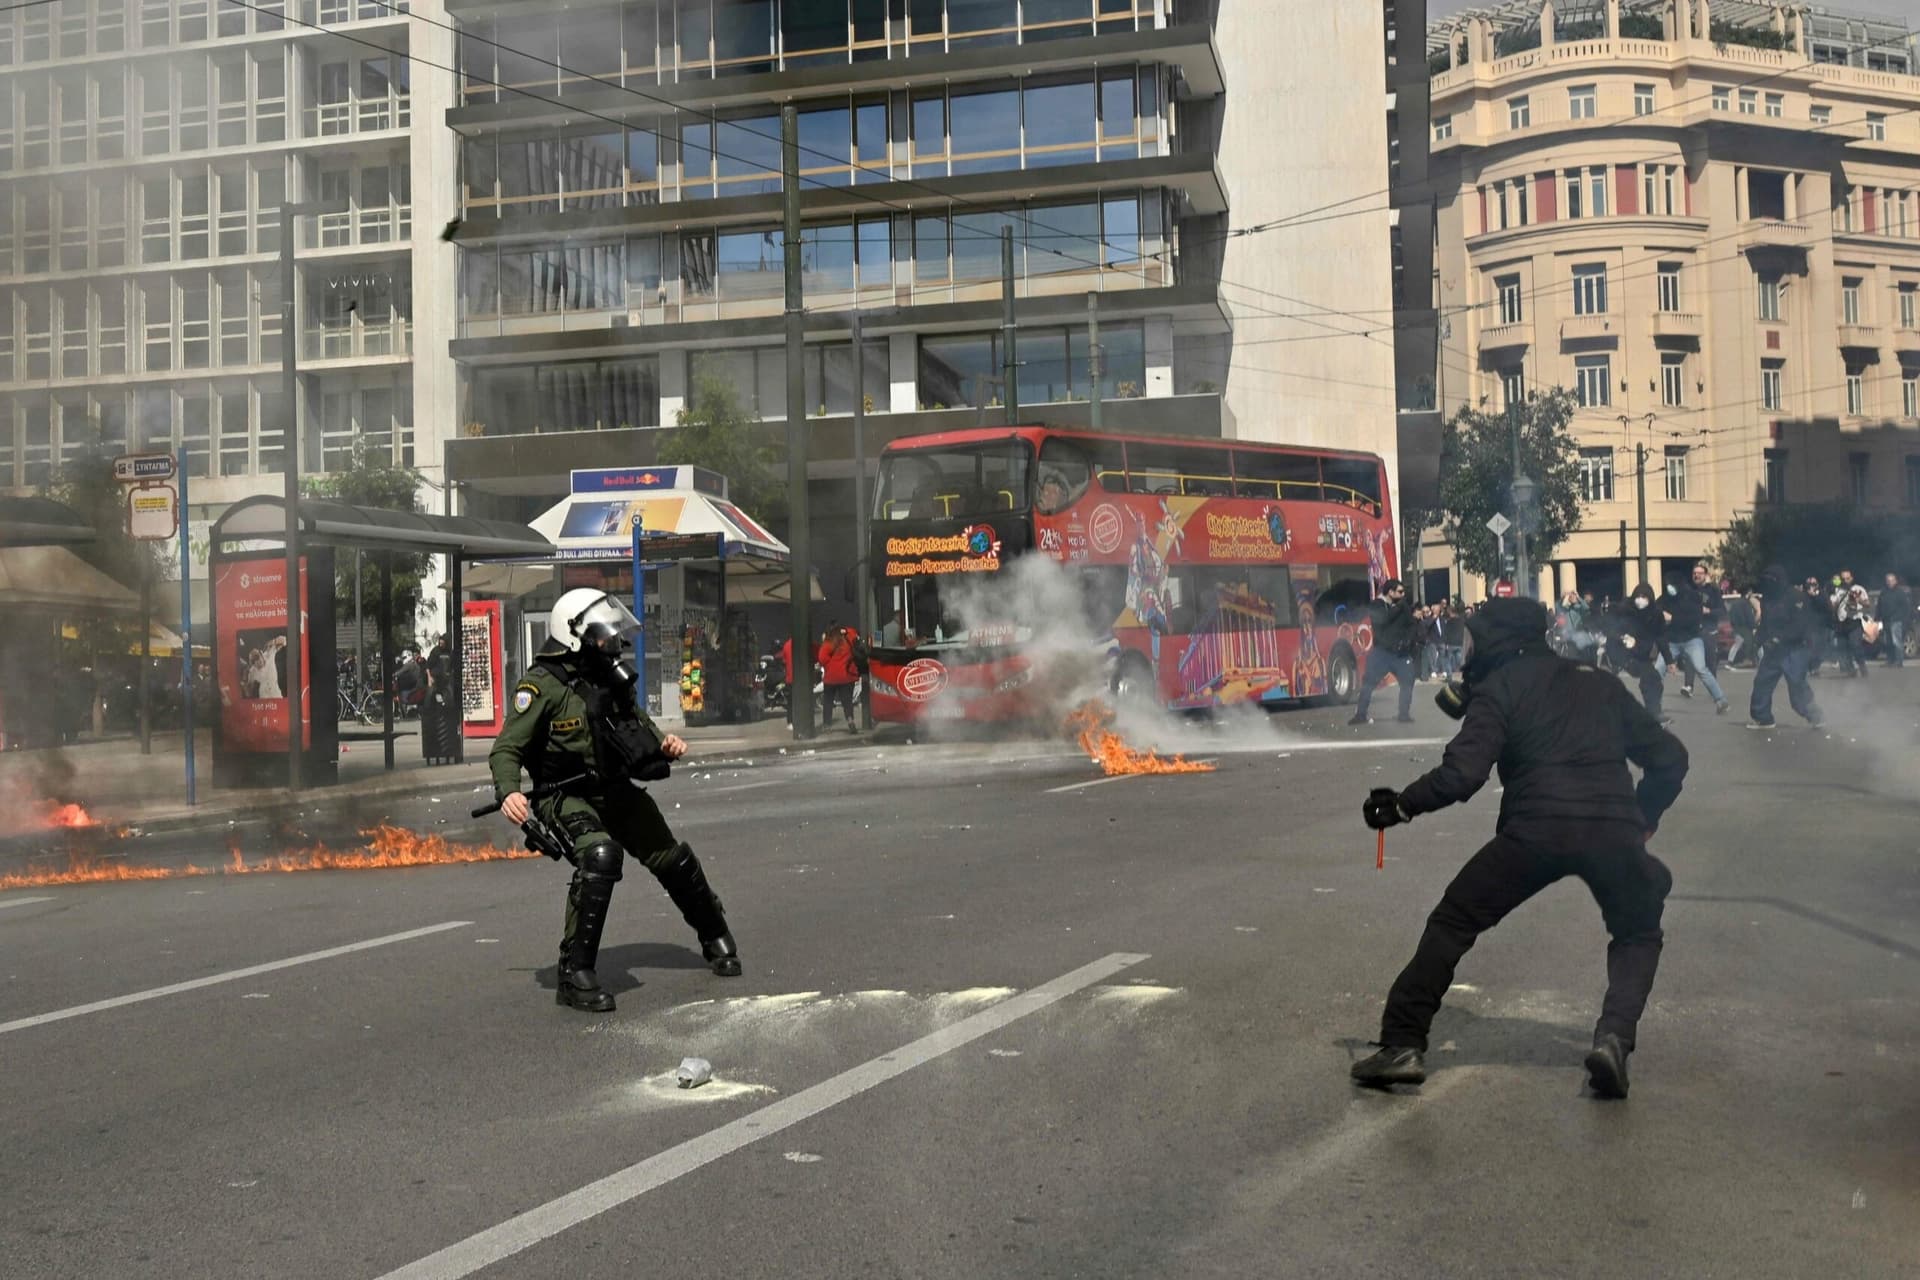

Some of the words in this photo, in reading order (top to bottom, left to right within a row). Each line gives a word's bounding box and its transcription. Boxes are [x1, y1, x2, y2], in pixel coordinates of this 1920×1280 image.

[135, 461, 169, 472] ΣΥΝΤΑΓΜΑ
[886, 561, 917, 577] Athens
[921, 558, 956, 574] Piraeus
[961, 556, 999, 572] Beaches
